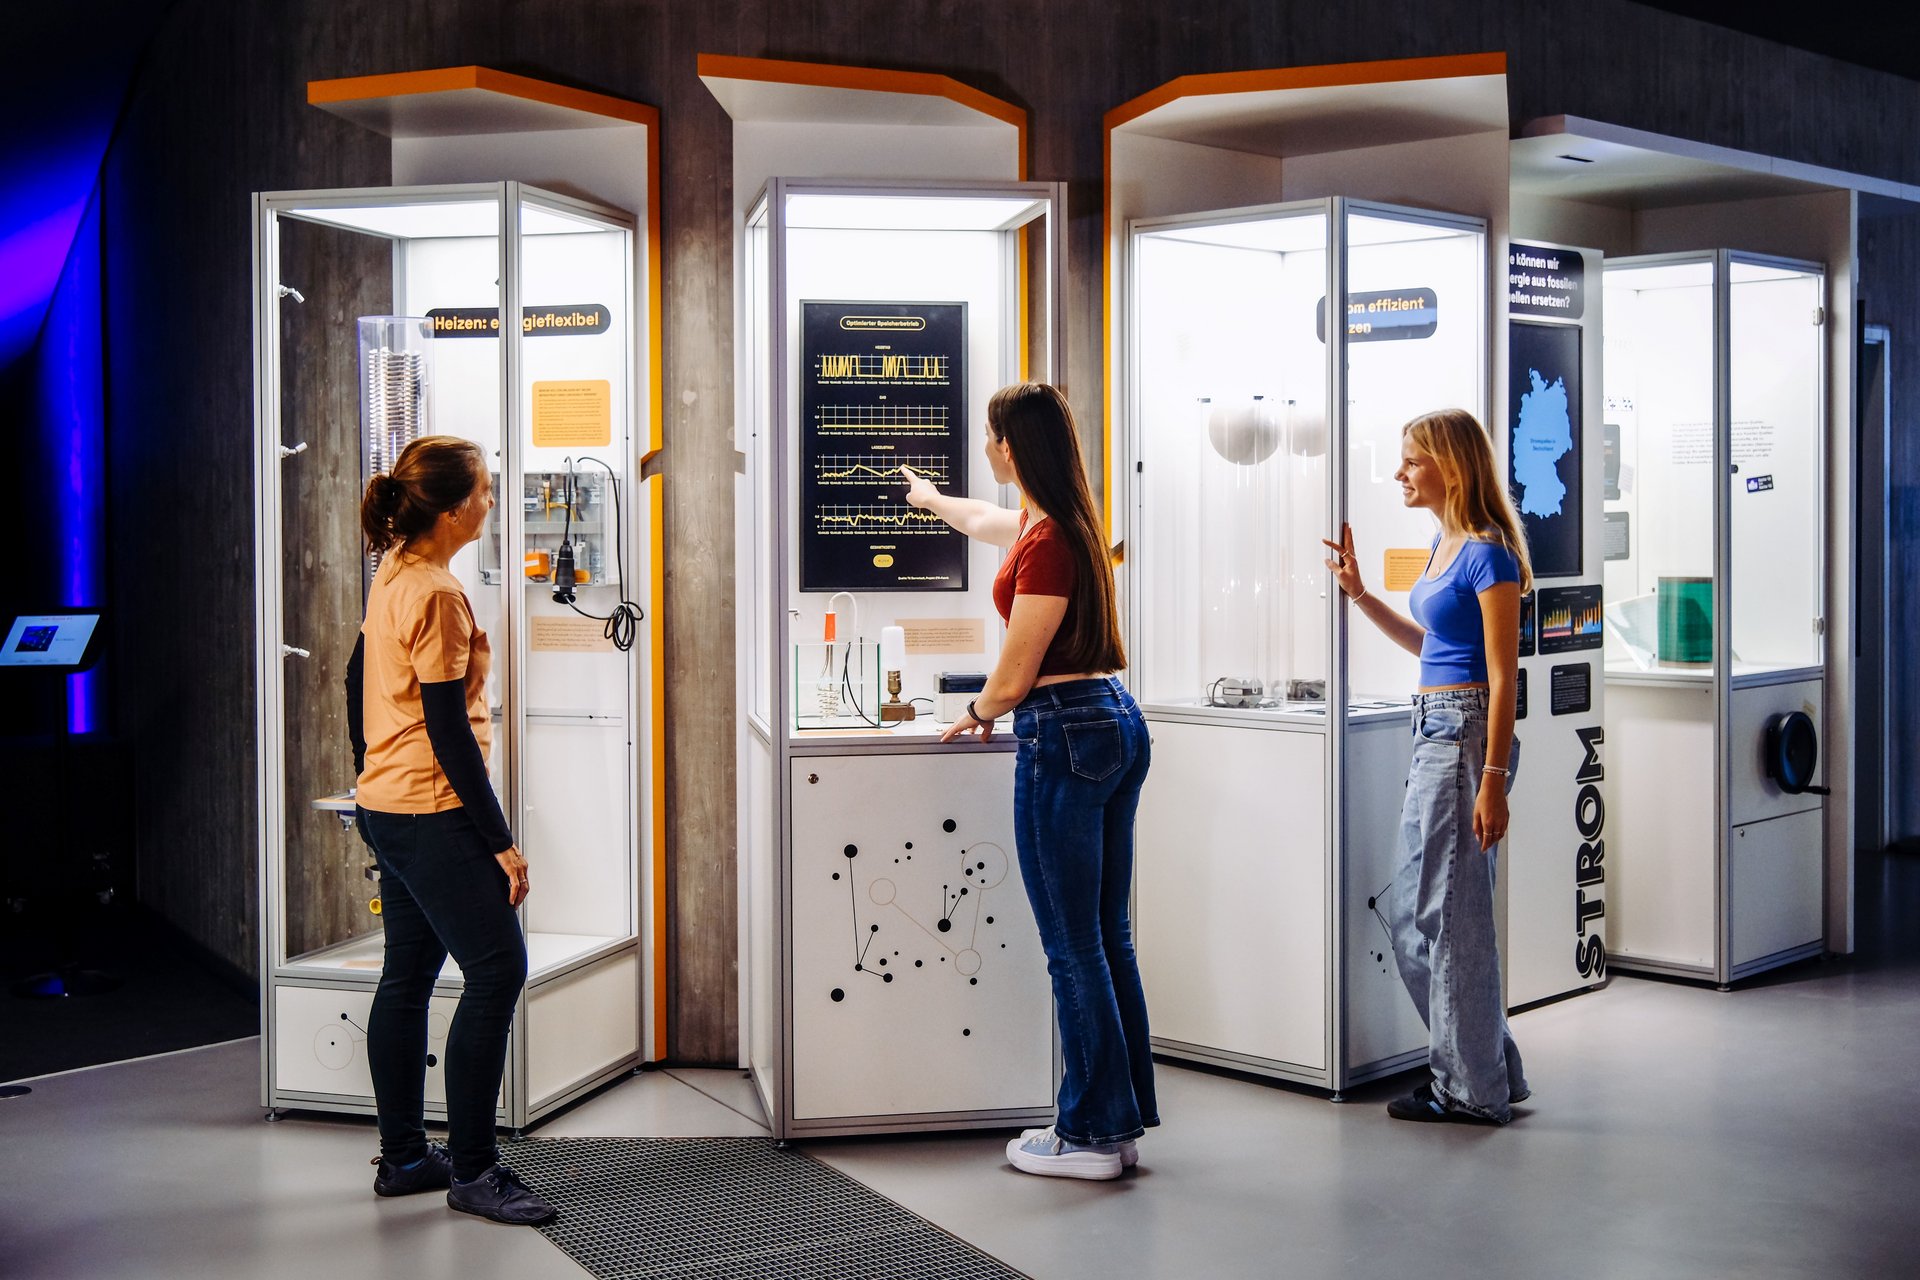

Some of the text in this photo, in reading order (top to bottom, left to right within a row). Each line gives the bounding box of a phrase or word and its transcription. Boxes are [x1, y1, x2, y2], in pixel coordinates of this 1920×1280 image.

[1516, 253, 1546, 269] können
[1547, 257, 1560, 270] wir
[1509, 272, 1578, 291] ergie aus fossilen
[1368, 297, 1425, 314] effizient
[1509, 290, 1570, 309] ellen ersetzen?
[435, 312, 599, 332] Heizen: egieflexibel
[846, 320, 877, 328] Optimierter
[1348, 322, 1372, 335] zen
[1575, 726, 1605, 979] STROM
